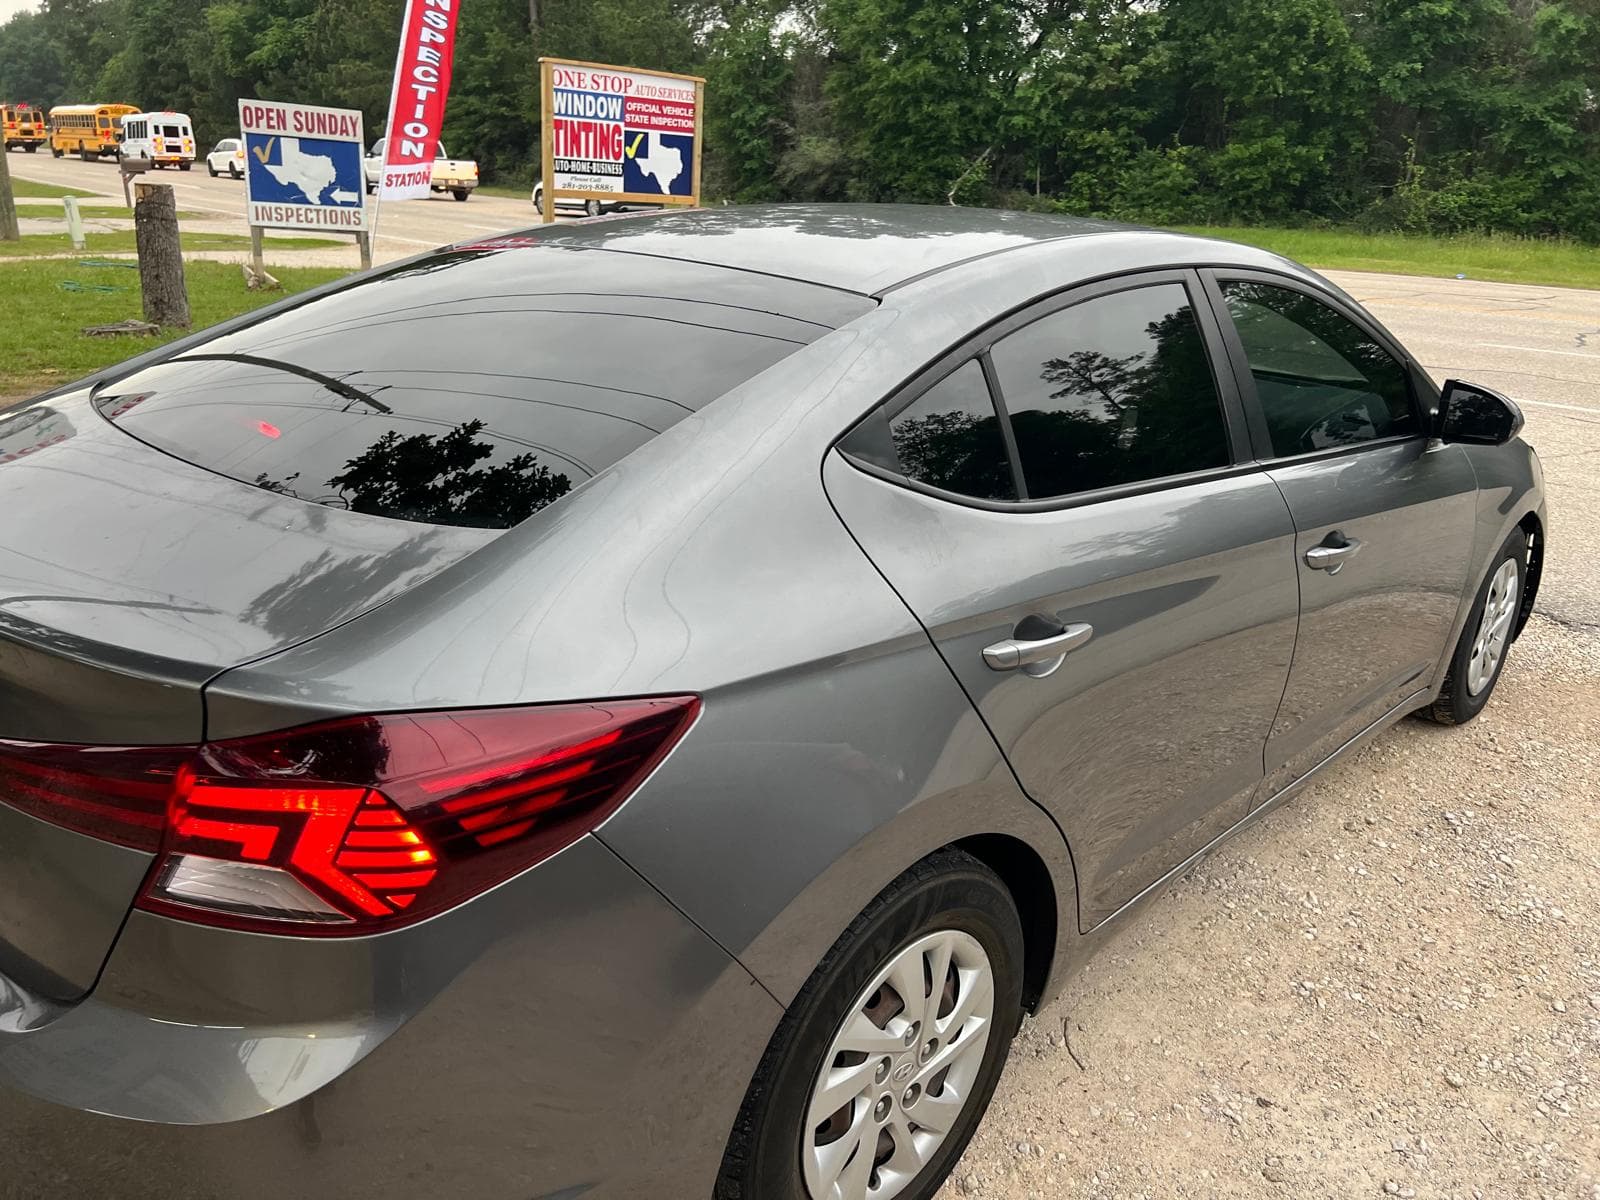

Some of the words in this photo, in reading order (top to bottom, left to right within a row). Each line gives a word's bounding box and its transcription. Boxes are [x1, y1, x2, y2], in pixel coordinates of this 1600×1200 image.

[553, 69, 587, 90] ONE
[590, 74, 633, 94] STOP
[634, 84, 657, 97] AUTO
[553, 91, 622, 120] WINDOW
[626, 102, 662, 114] OFFICIAL
[662, 105, 694, 117] VEHICLE
[242, 105, 288, 131] OPEN
[293, 110, 359, 138] SUNDAY
[625, 113, 649, 124] STATE
[650, 115, 695, 128] INSPECTION
[553, 119, 623, 161] TINTING
[554, 159, 623, 175] UTO-HOME-BUSINESS
[385, 170, 431, 188] STATION
[255, 205, 362, 226] INSPECTIONS
